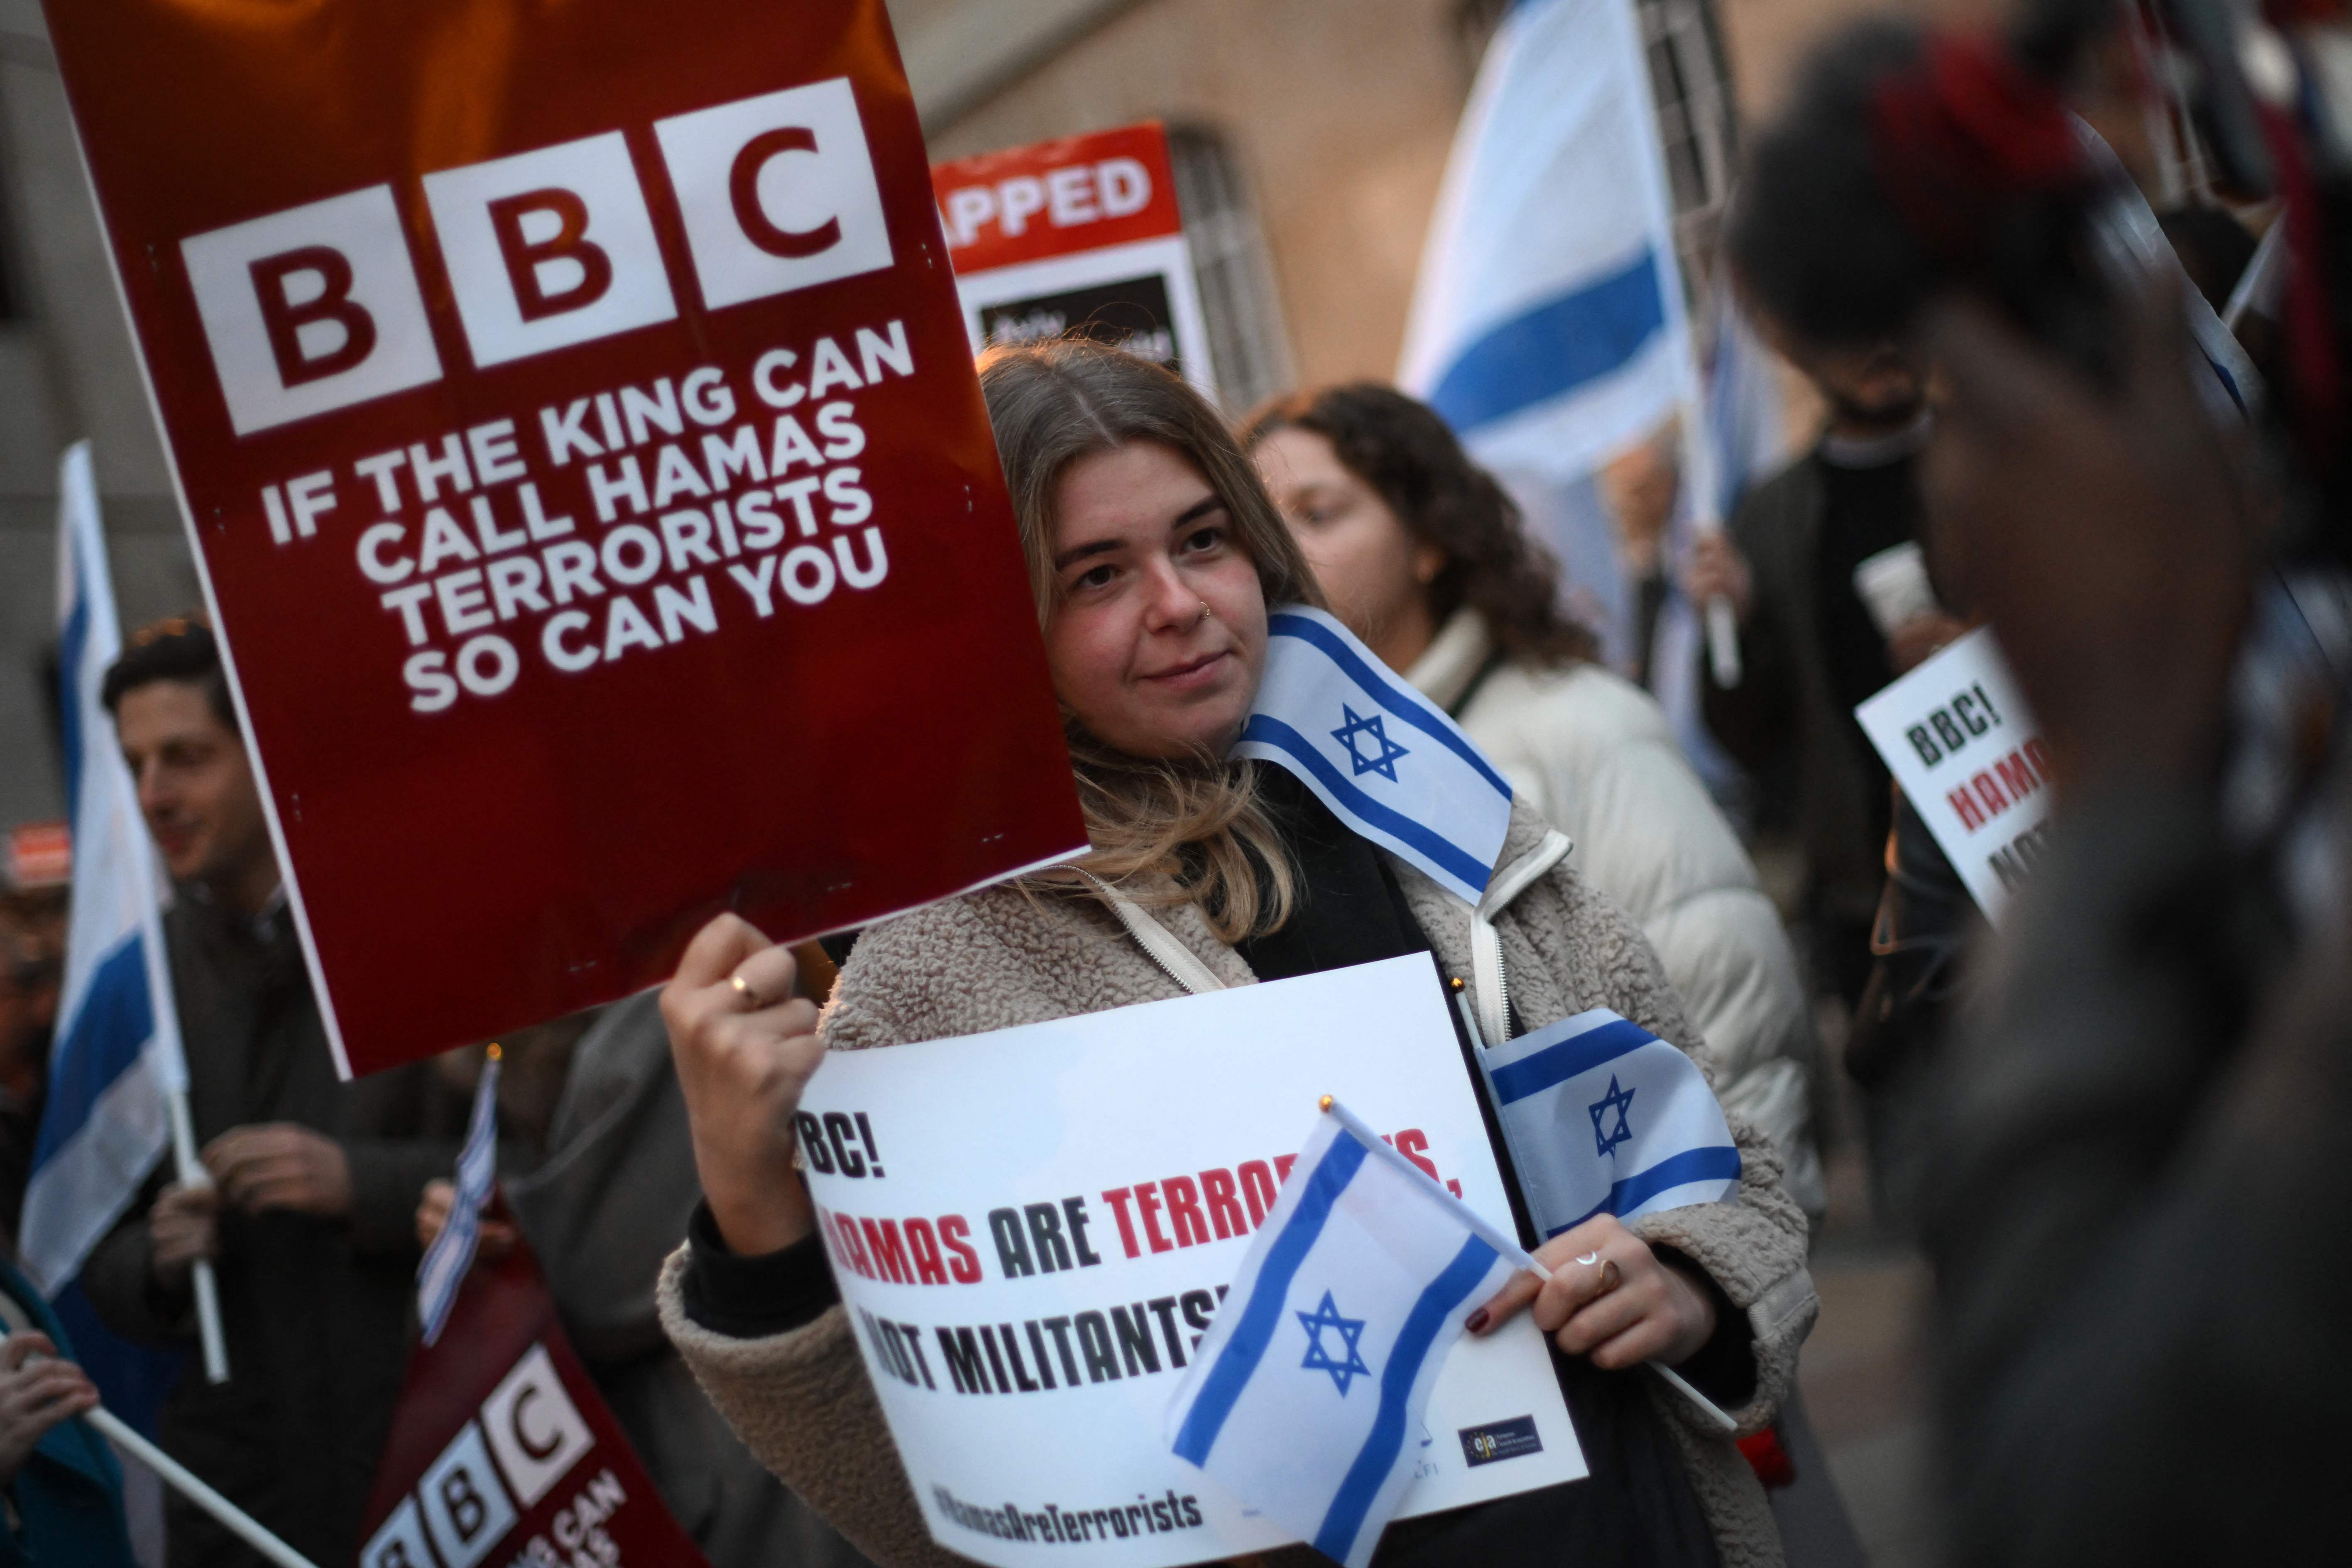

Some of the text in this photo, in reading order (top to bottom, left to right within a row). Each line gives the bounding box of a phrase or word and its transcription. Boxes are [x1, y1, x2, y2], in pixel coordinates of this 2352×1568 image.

[247, 126, 842, 389] BBC
[939, 156, 1153, 248] PPED
[263, 320, 915, 544] IF THE KING CAN
[357, 401, 866, 584] CALL HAMAS
[381, 466, 873, 646] TERRORISTS
[404, 526, 888, 712] SO CAN YOU
[1907, 683, 2001, 766] BBC!
[1947, 737, 2052, 832] HAMA
[794, 1110, 886, 1179] BC!
[987, 1194, 1102, 1276] ARE
[1101, 1128, 1463, 1259] TERROS,
[935, 1283, 1230, 1394] MILITANTS
